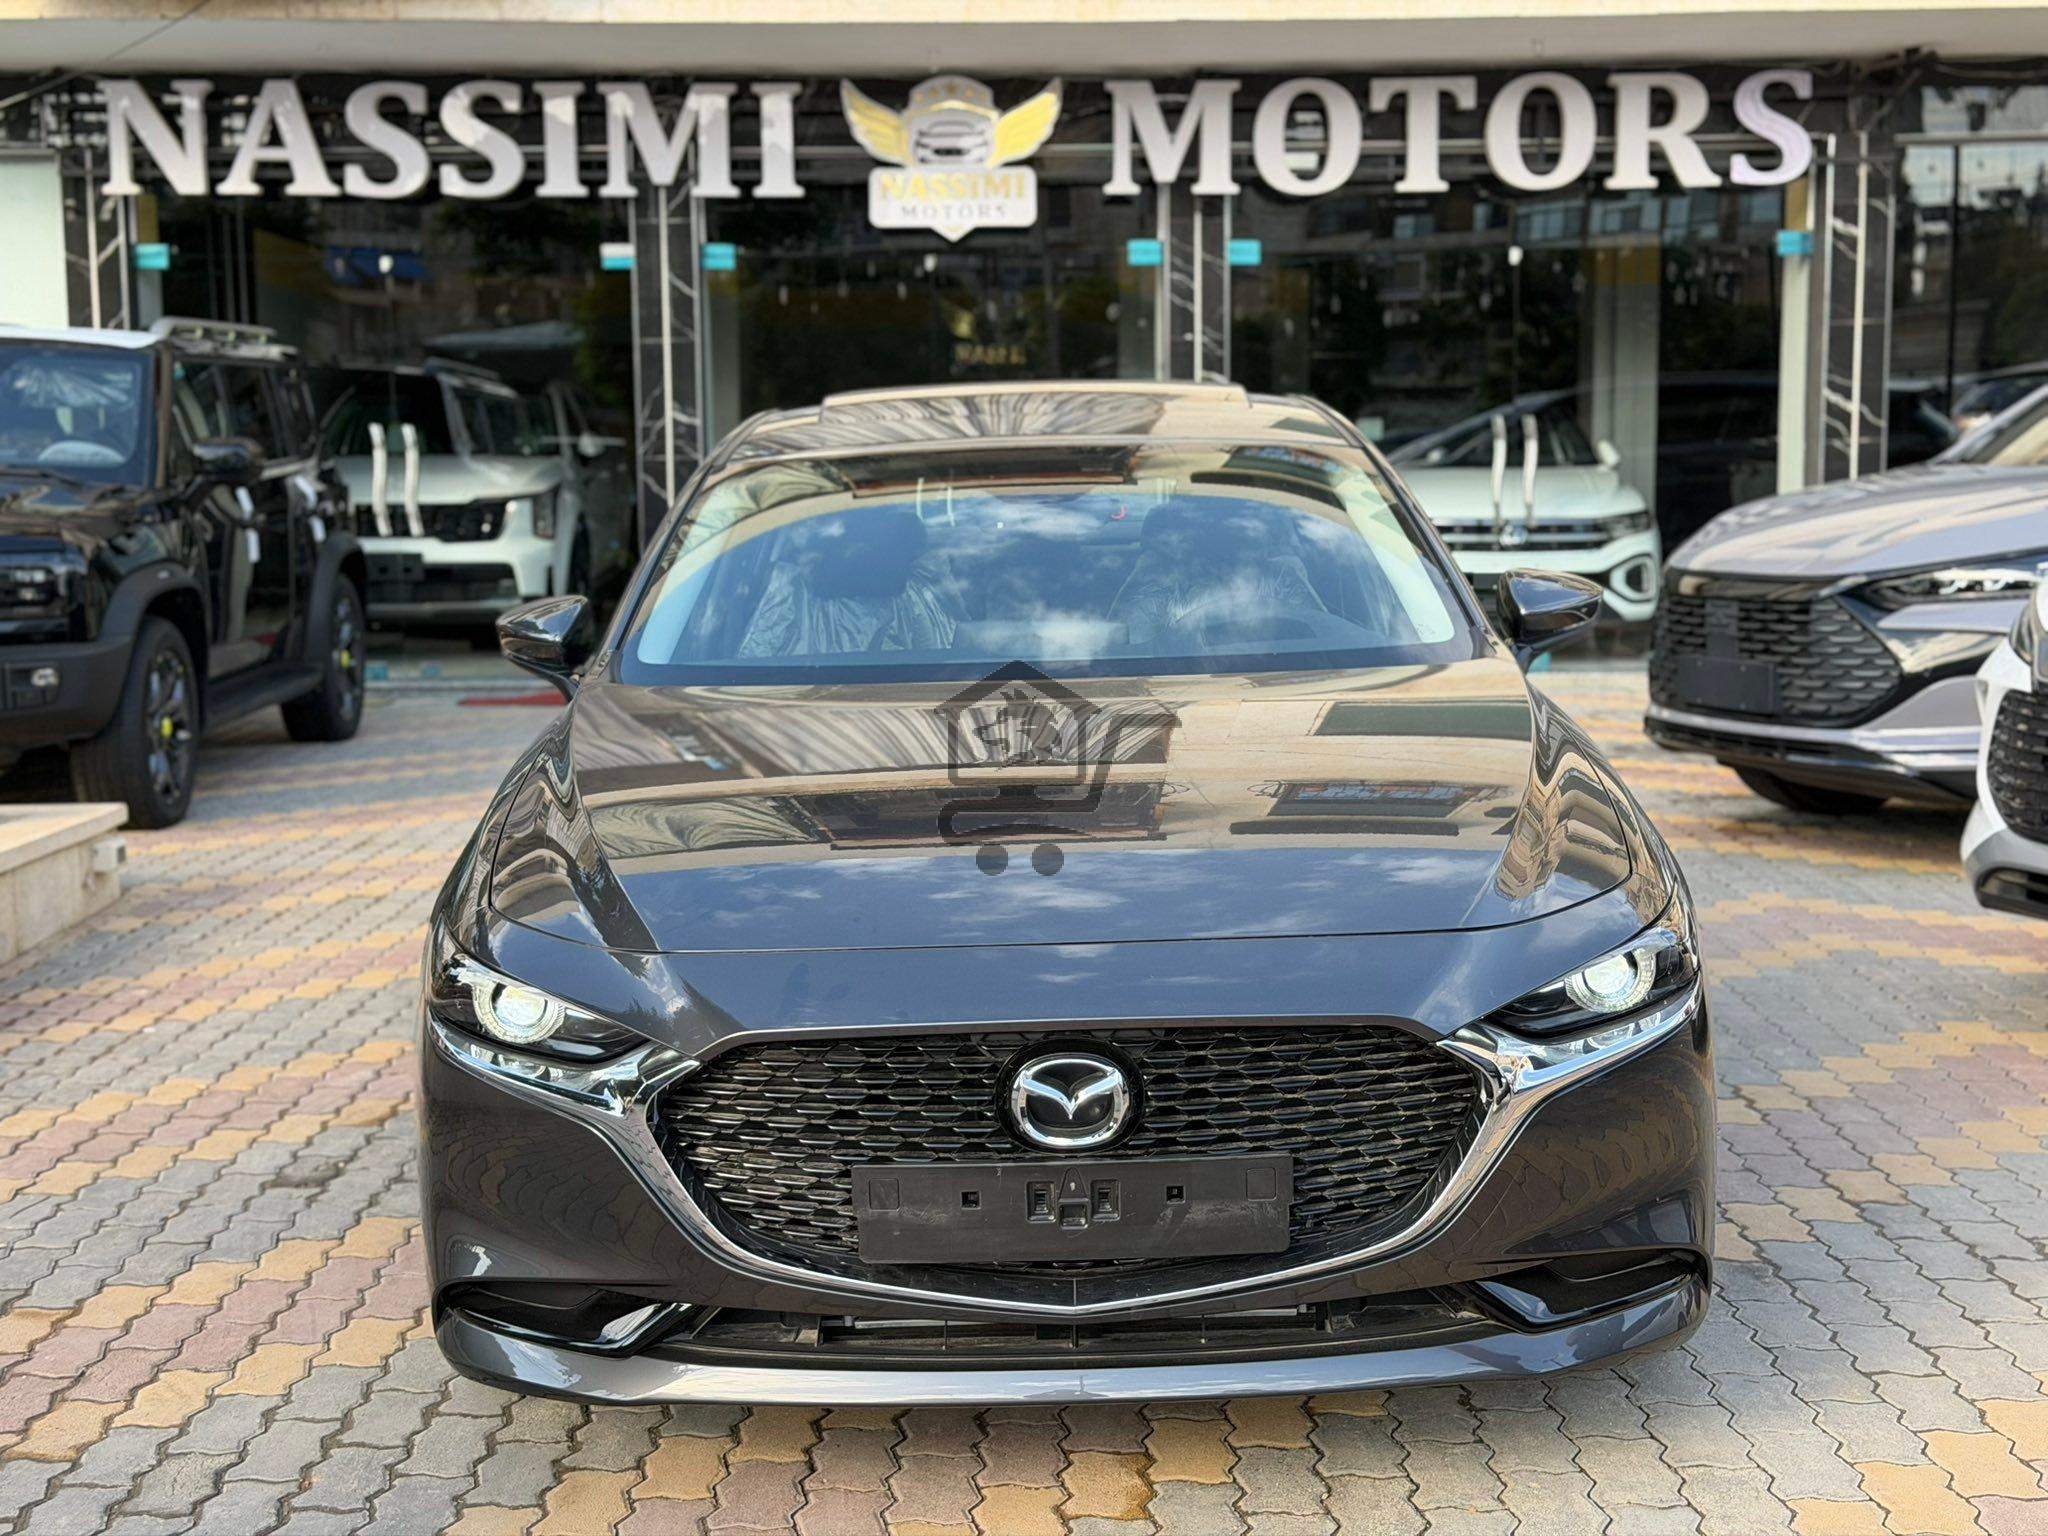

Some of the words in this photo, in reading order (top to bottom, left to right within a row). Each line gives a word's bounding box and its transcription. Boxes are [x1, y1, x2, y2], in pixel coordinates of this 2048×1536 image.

[97, 79, 805, 198] NASSIMI
[1102, 69, 1813, 197] MOTORS
[880, 173, 1026, 200] NASSIMI
[902, 204, 1006, 220] MOTORS
